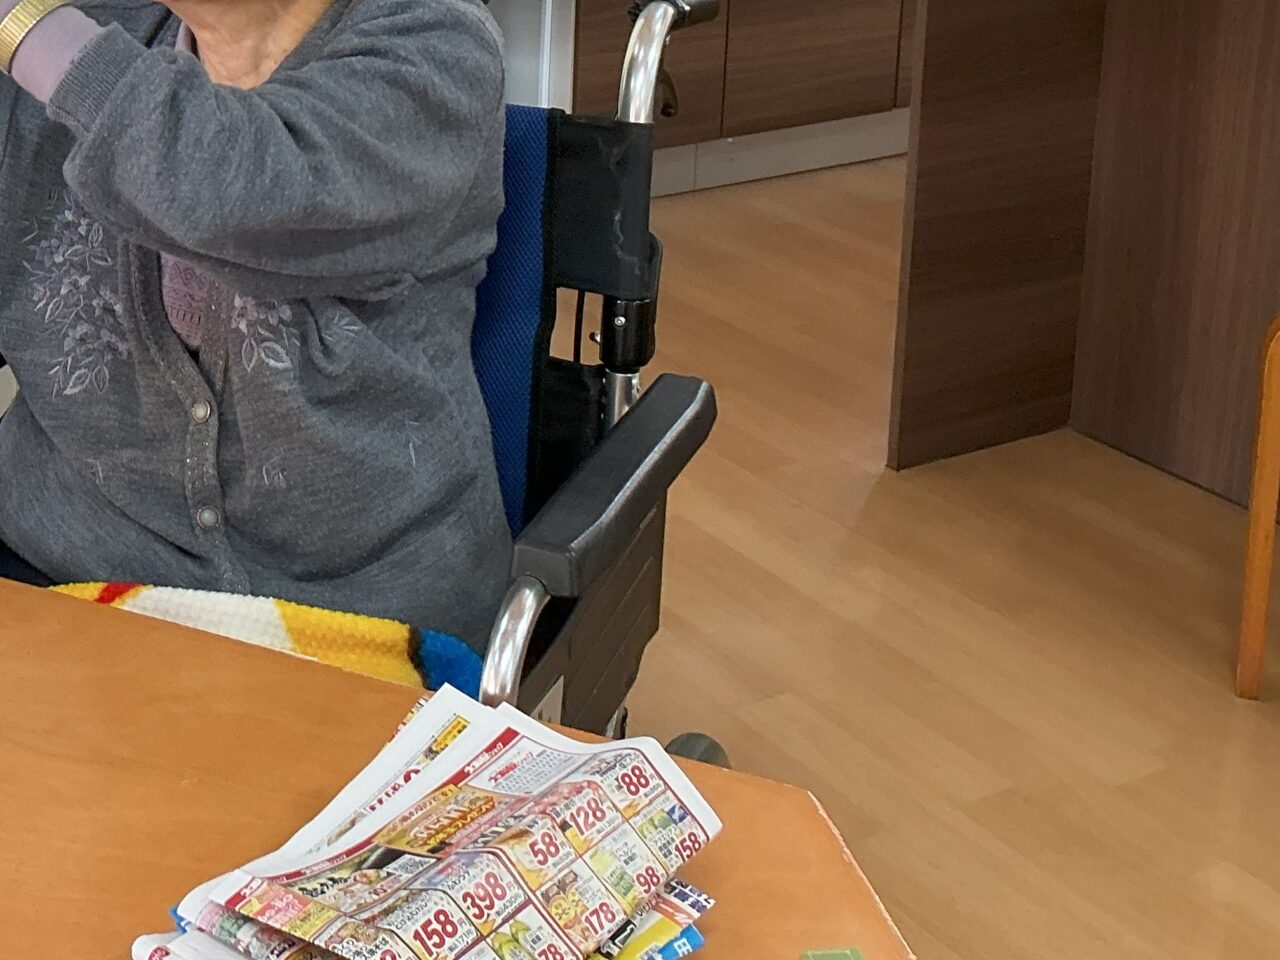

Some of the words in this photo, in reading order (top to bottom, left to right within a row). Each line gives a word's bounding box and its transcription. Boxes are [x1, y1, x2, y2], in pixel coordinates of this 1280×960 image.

[620, 764, 650, 796] 88
[569, 797, 607, 836] 128
[528, 831, 560, 866] 58
[674, 832, 702, 864] 158
[461, 871, 508, 920] 398
[635, 865, 661, 894] 98
[412, 909, 458, 958] 158
[584, 902, 617, 936] 178
